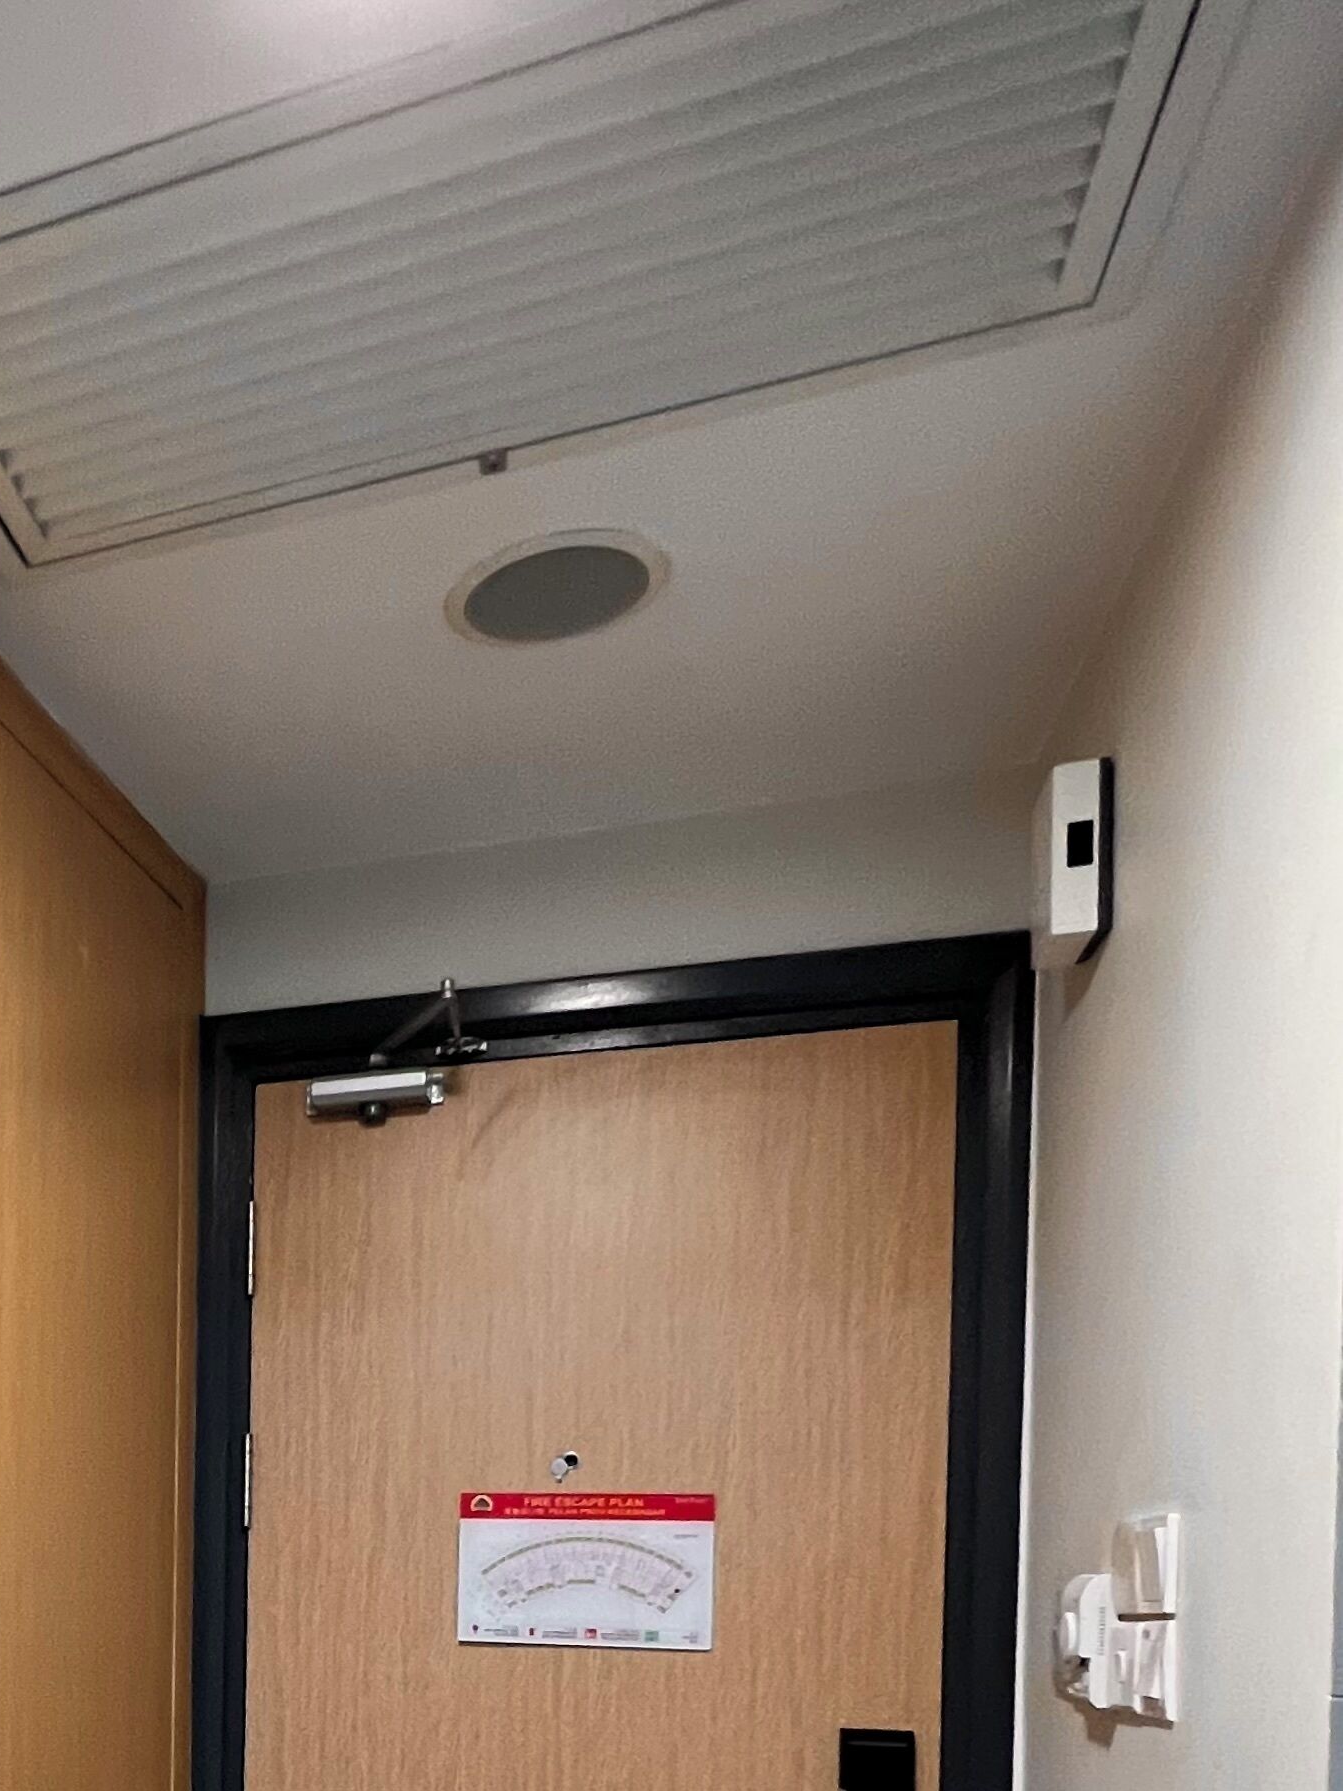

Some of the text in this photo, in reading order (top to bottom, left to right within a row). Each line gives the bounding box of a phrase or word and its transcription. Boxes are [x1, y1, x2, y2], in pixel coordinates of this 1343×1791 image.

[523, 1496, 645, 1507] FIRE ESCAPE PLAN
